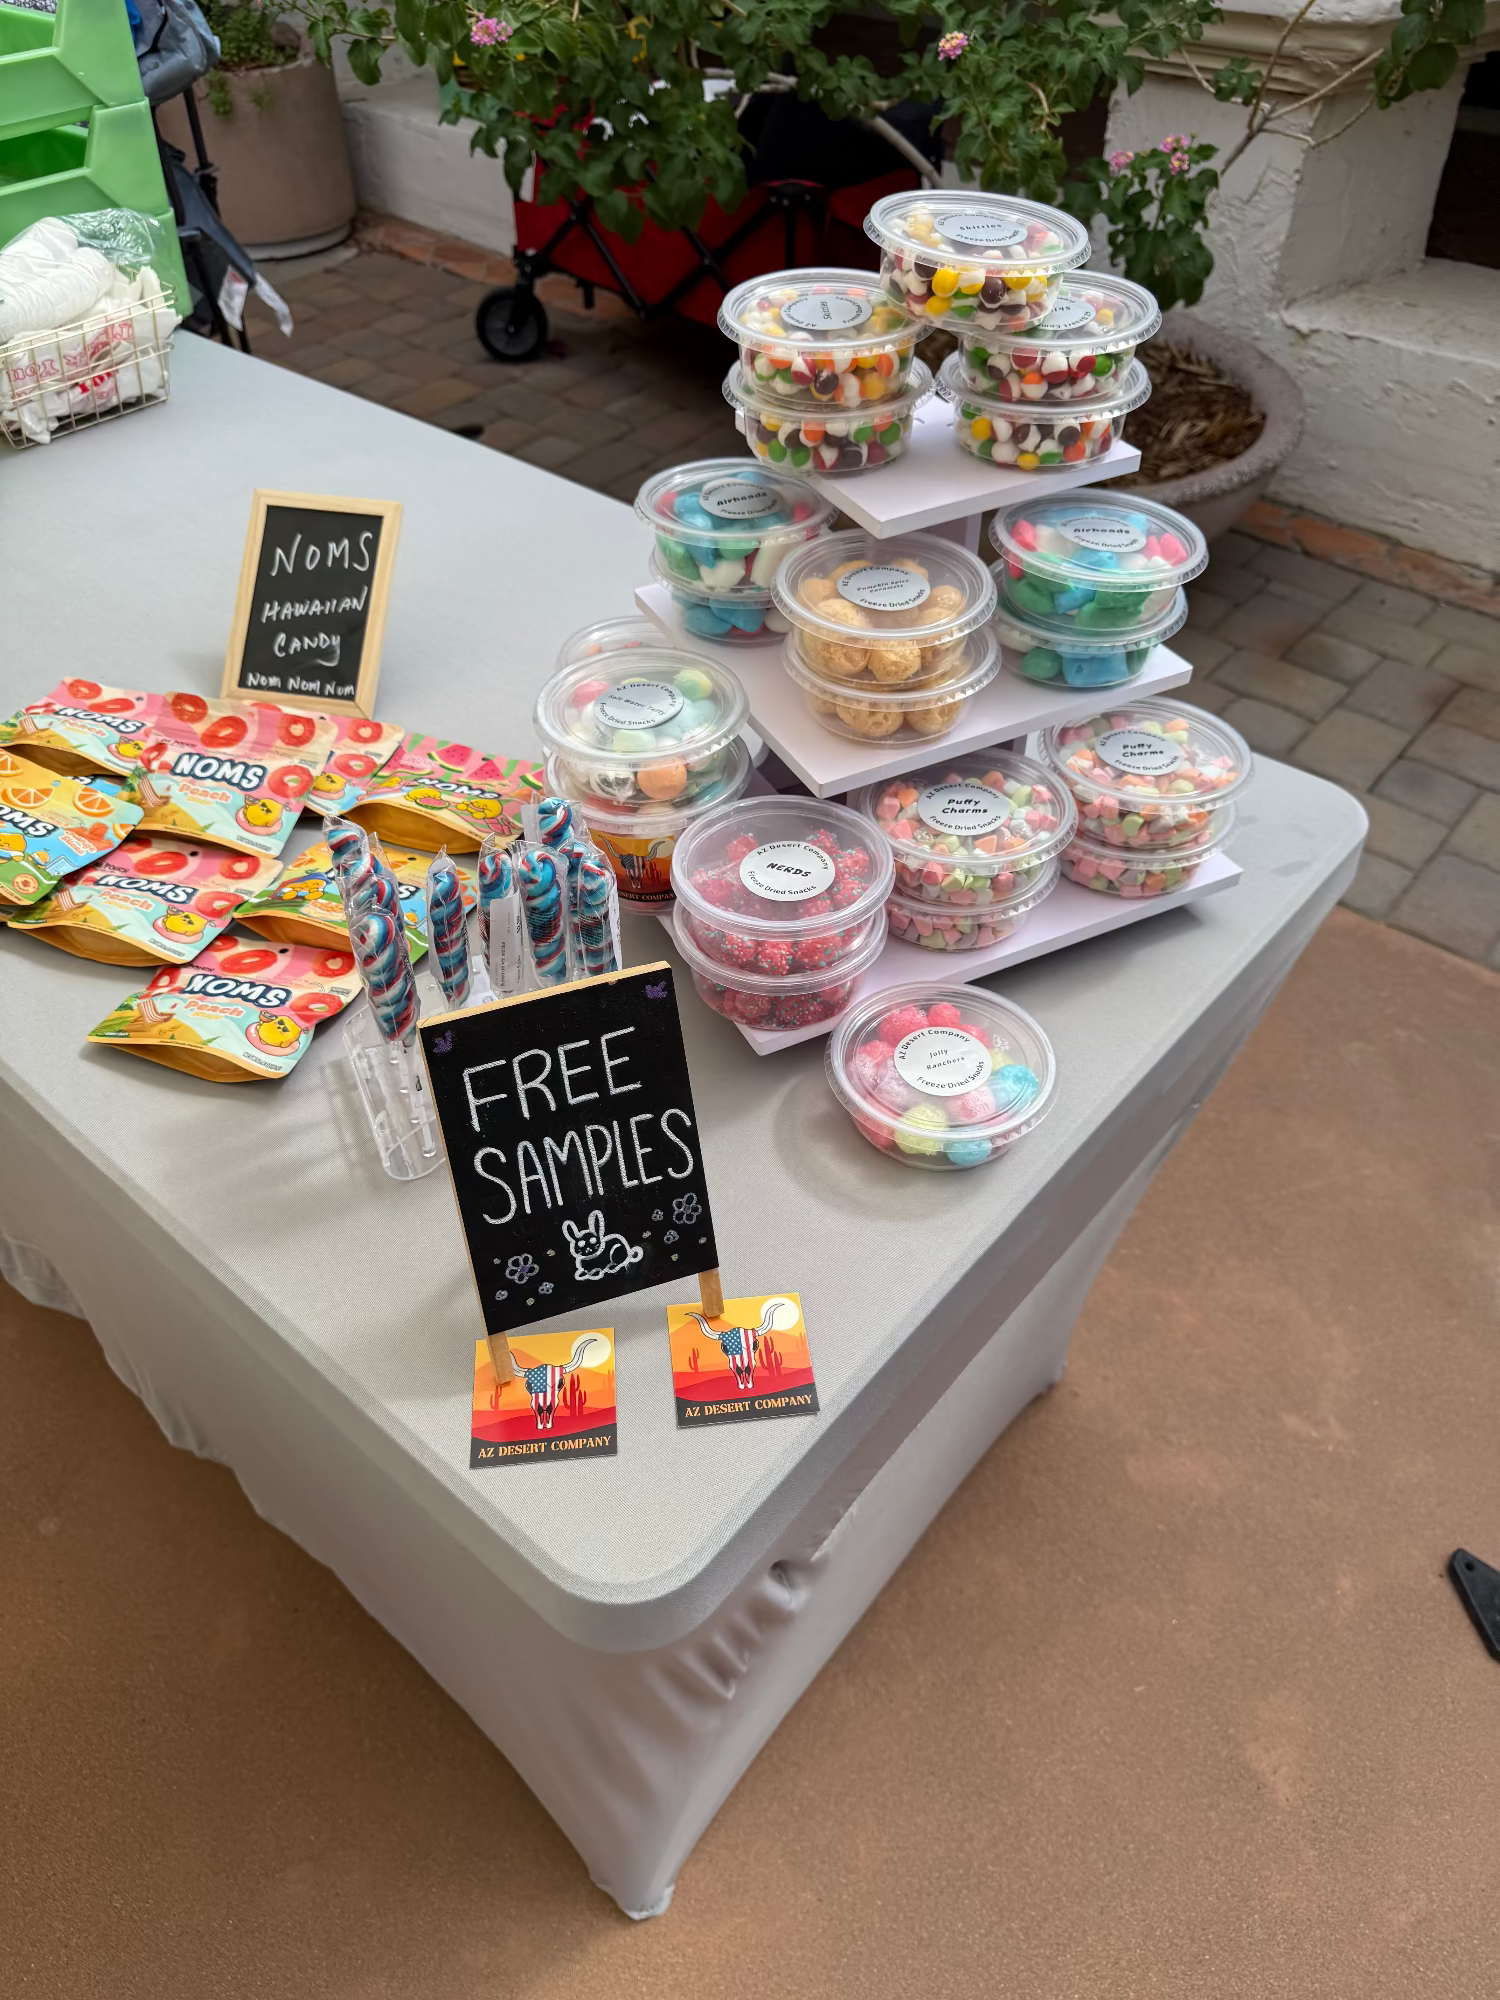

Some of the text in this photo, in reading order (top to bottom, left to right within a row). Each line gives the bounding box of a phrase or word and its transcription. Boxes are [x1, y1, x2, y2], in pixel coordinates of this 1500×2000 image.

[717, 492, 768, 507] Airheads
[270, 530, 373, 577] NOMS
[869, 566, 911, 576] Company
[260, 585, 369, 624] HAWAIIAN
[859, 598, 888, 608] Freeze
[908, 589, 926, 603] Snacks
[660, 685, 677, 708] Company
[57, 707, 142, 733] NOMS
[600, 702, 609, 718] Freeze
[608, 715, 627, 725] Dried
[1114, 759, 1141, 770] Freeze
[1122, 750, 1164, 758] Charms
[174, 753, 264, 790] NOMS
[178, 782, 232, 803] Peach
[418, 777, 501, 799] NOMS
[934, 783, 962, 793] Desert
[964, 783, 1000, 799] Company
[947, 799, 981, 807] Puffy
[929, 815, 954, 829] Freeze
[977, 815, 1001, 829] Snacks
[769, 843, 801, 851] Desert
[803, 845, 829, 871] Company
[766, 862, 812, 877] NERDS
[99, 875, 194, 902] NOMS
[748, 870, 817, 895] Freeze Dried Snacks
[100, 890, 155, 911] Peach
[619, 891, 675, 901] SERT COMPAN
[186, 974, 286, 1006] NOMS
[183, 999, 244, 1017] Peach
[901, 1032, 926, 1050] Desert
[927, 1029, 971, 1043] Company
[926, 1056, 965, 1070] Ranchers
[929, 1048, 948, 1058] Jolly
[462, 1026, 643, 1133] FREE
[916, 1061, 985, 1089] Freeze Dried Snacks
[473, 1108, 694, 1225] SAMPLES
[685, 1394, 813, 1418] AZ DESERT COMPANY
[477, 1435, 612, 1460] AZ DESERT COMPANY
